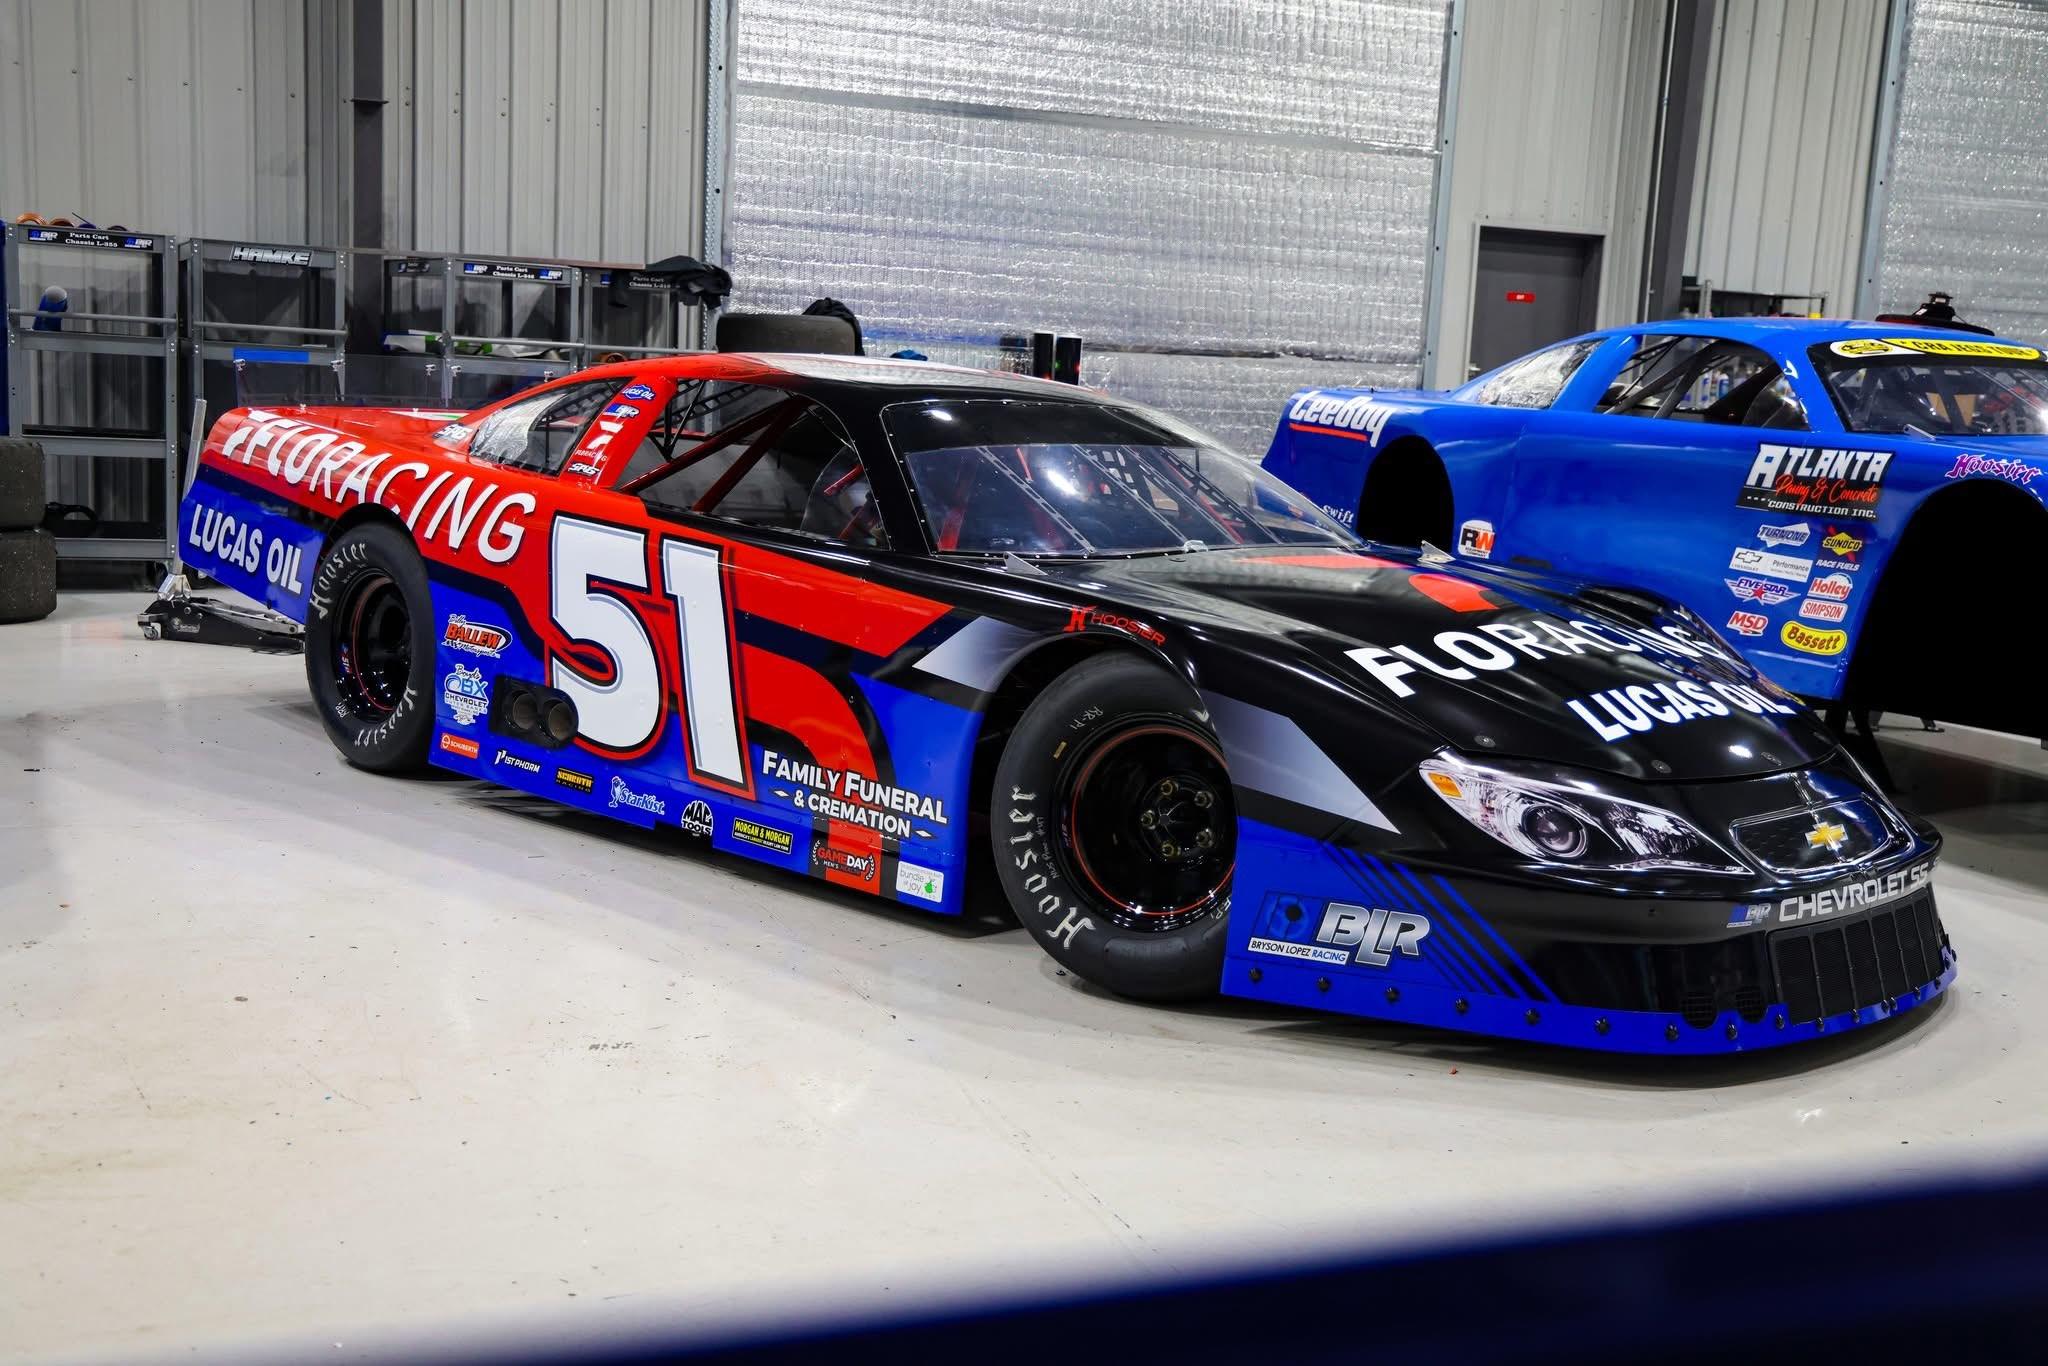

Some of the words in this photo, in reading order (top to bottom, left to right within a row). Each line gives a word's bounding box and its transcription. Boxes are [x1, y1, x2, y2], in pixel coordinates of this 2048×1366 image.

[233, 247, 310, 266] HAMKE
[641, 391, 655, 400] OIL
[1745, 443, 1893, 488] ATLANTA
[189, 503, 262, 574] LUCAS
[266, 544, 303, 594] OIL
[1461, 528, 1494, 551] RW
[1824, 537, 1861, 551] SUNOCO
[1772, 559, 1809, 573] Performance
[1816, 559, 1838, 569] RACE
[1839, 561, 1860, 571] FUELS
[1737, 578, 1761, 589] FIVE
[1763, 582, 1787, 596] STAR
[1810, 578, 1850, 601] Holley
[1729, 612, 1767, 630] MSD
[1803, 601, 1844, 619] SIMPSON
[445, 623, 502, 650] BALLEW
[1090, 611, 1167, 646] HOOSIER
[1787, 625, 1841, 650] Bassett
[550, 512, 750, 790] 51
[445, 692, 488, 708] CHEVROLET
[1567, 680, 1730, 741] LUCAS
[1708, 681, 1797, 715] OIL
[763, 750, 840, 792] FAMILY
[844, 772, 948, 824] FUNERAL
[682, 800, 713, 828] MAC
[793, 789, 805, 808] &
[808, 795, 911, 838] CREMATION
[735, 820, 760, 837] MORGAN
[760, 827, 765, 838] &
[765, 829, 790, 846] MORGAN
[1009, 784, 1097, 950] Hoosier
[1779, 869, 1908, 922] CHEVROLET
[1316, 902, 1431, 967] BLR
[1251, 940, 1285, 953] BRYSON
[1285, 946, 1311, 957] LOPEZ
[1311, 950, 1346, 962] RACING
